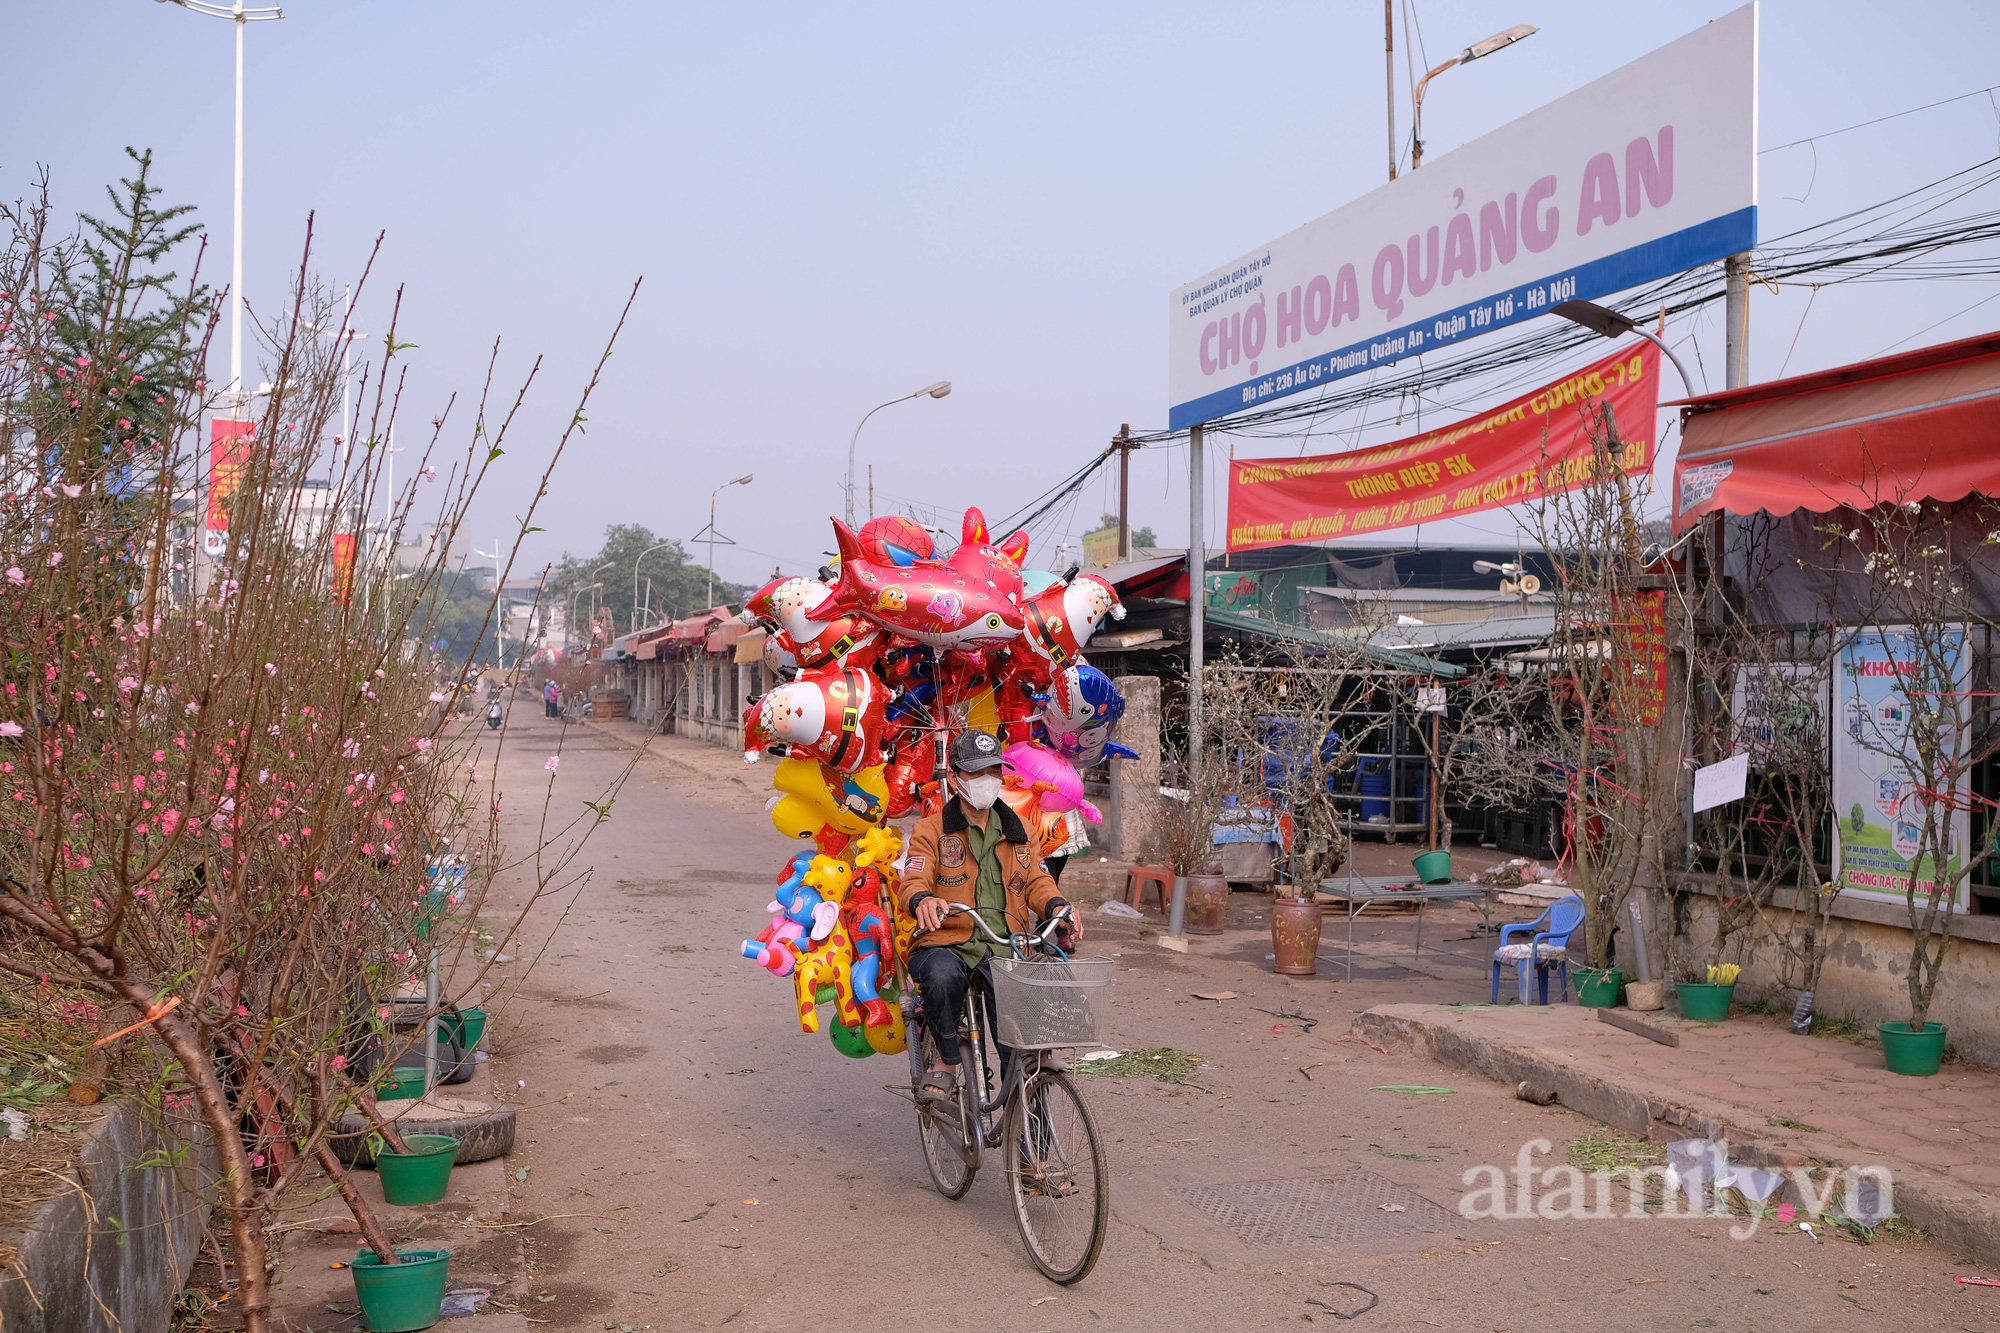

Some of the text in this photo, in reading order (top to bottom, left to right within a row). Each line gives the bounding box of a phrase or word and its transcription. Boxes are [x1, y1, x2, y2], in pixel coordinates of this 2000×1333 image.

[1199, 124, 1674, 376] CHỢ HOA QUẢNG AN
[1190, 275, 1262, 317] BAN QUẢN LÝ CHỢ QUẬN
[1191, 289, 1201, 301] BAN
[1202, 281, 1217, 296] NHÂN
[1219, 274, 1230, 288] DÂN
[1232, 267, 1247, 283] QUẬN
[1249, 260, 1260, 273] TÂY
[1243, 386, 1257, 404] Địa
[1258, 378, 1274, 397] chỉ:
[1276, 372, 1292, 391] 236
[1294, 366, 1307, 386] Âu
[1309, 363, 1322, 380] Cơ
[1330, 348, 1368, 374] Phường
[1370, 337, 1405, 361] Quảng
[1408, 329, 1423, 349] An
[1435, 315, 1466, 340] Quận
[1469, 306, 1492, 327] Tây
[1496, 294, 1514, 320] Hồ
[1527, 286, 1546, 310] Hà
[1550, 276, 1576, 302] Nội
[1232, 520, 1254, 546] KHẨU
[1255, 523, 1284, 543] TRANG
[1290, 514, 1312, 539] KHỬ
[1312, 508, 1346, 533] KHUẨN
[1351, 506, 1388, 531] KHÔNG
[1389, 502, 1409, 528] TẬP
[1410, 493, 1447, 519] TRUNG
[1452, 483, 1481, 510] KHAI
[1484, 473, 1510, 504] BÁO
[1511, 473, 1519, 497] Y
[1521, 464, 1538, 494] TẾ
[1548, 449, 1604, 488] KHOẢN
[1345, 452, 1476, 499] THÔNG ĐIỆP 5K
[1879, 874, 1897, 889] RÁC
